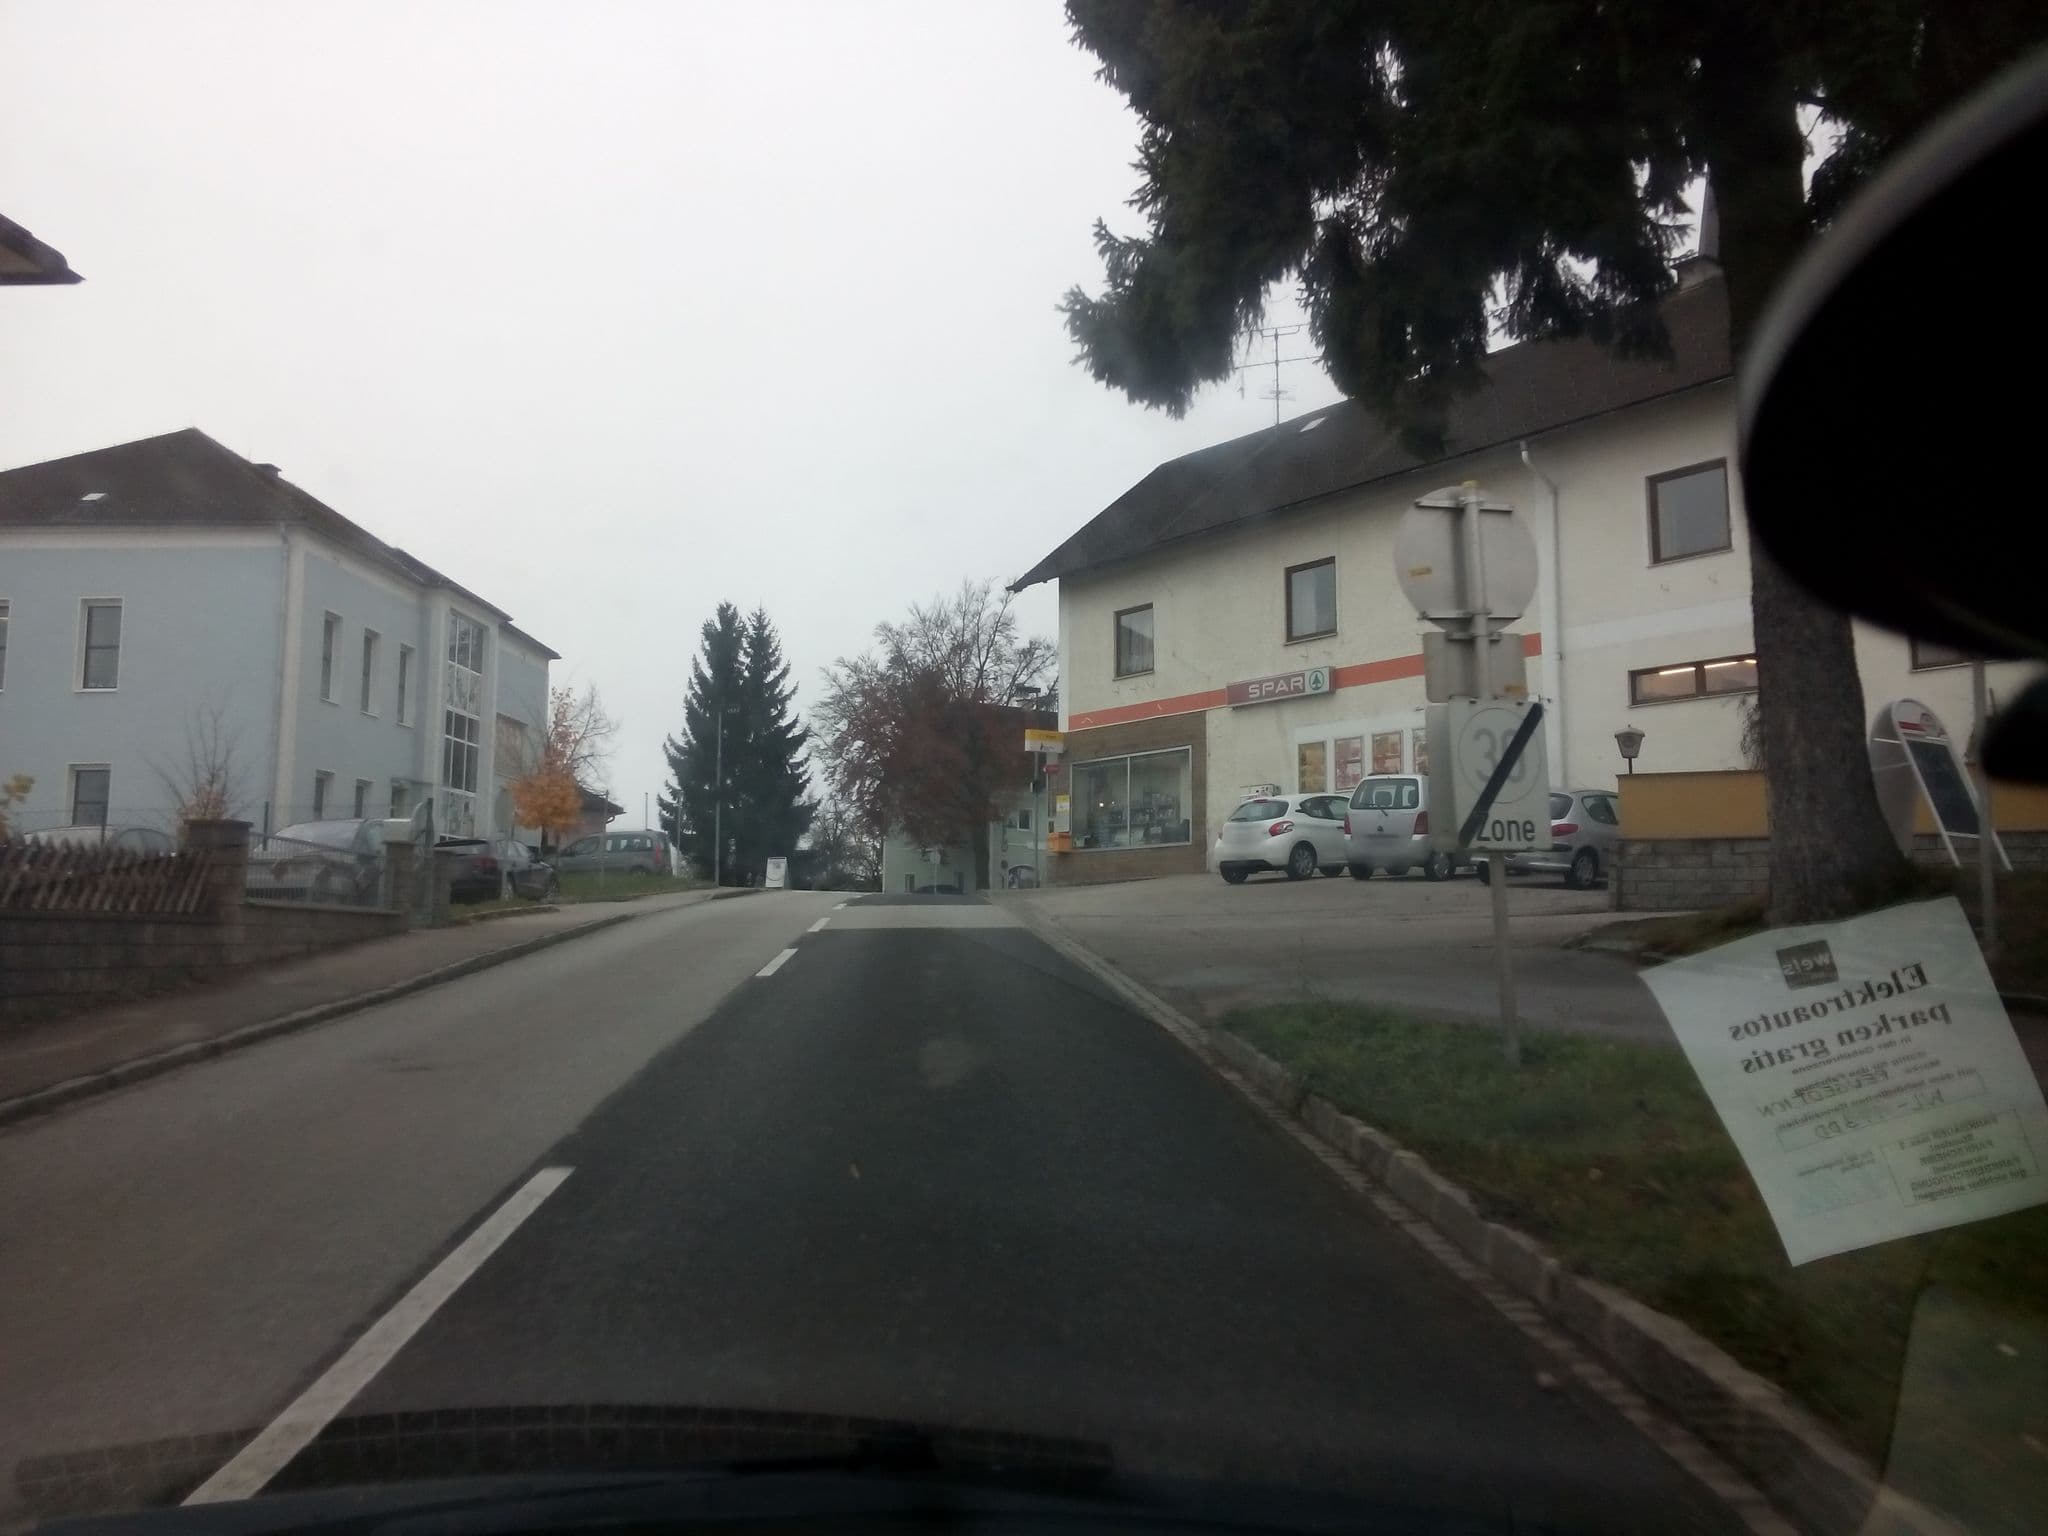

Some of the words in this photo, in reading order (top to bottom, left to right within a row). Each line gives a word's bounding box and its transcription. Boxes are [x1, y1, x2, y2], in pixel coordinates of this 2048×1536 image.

[1248, 676, 1303, 698] SPAR
[1472, 727, 1527, 783] 30
[1476, 811, 1535, 842] Zone
